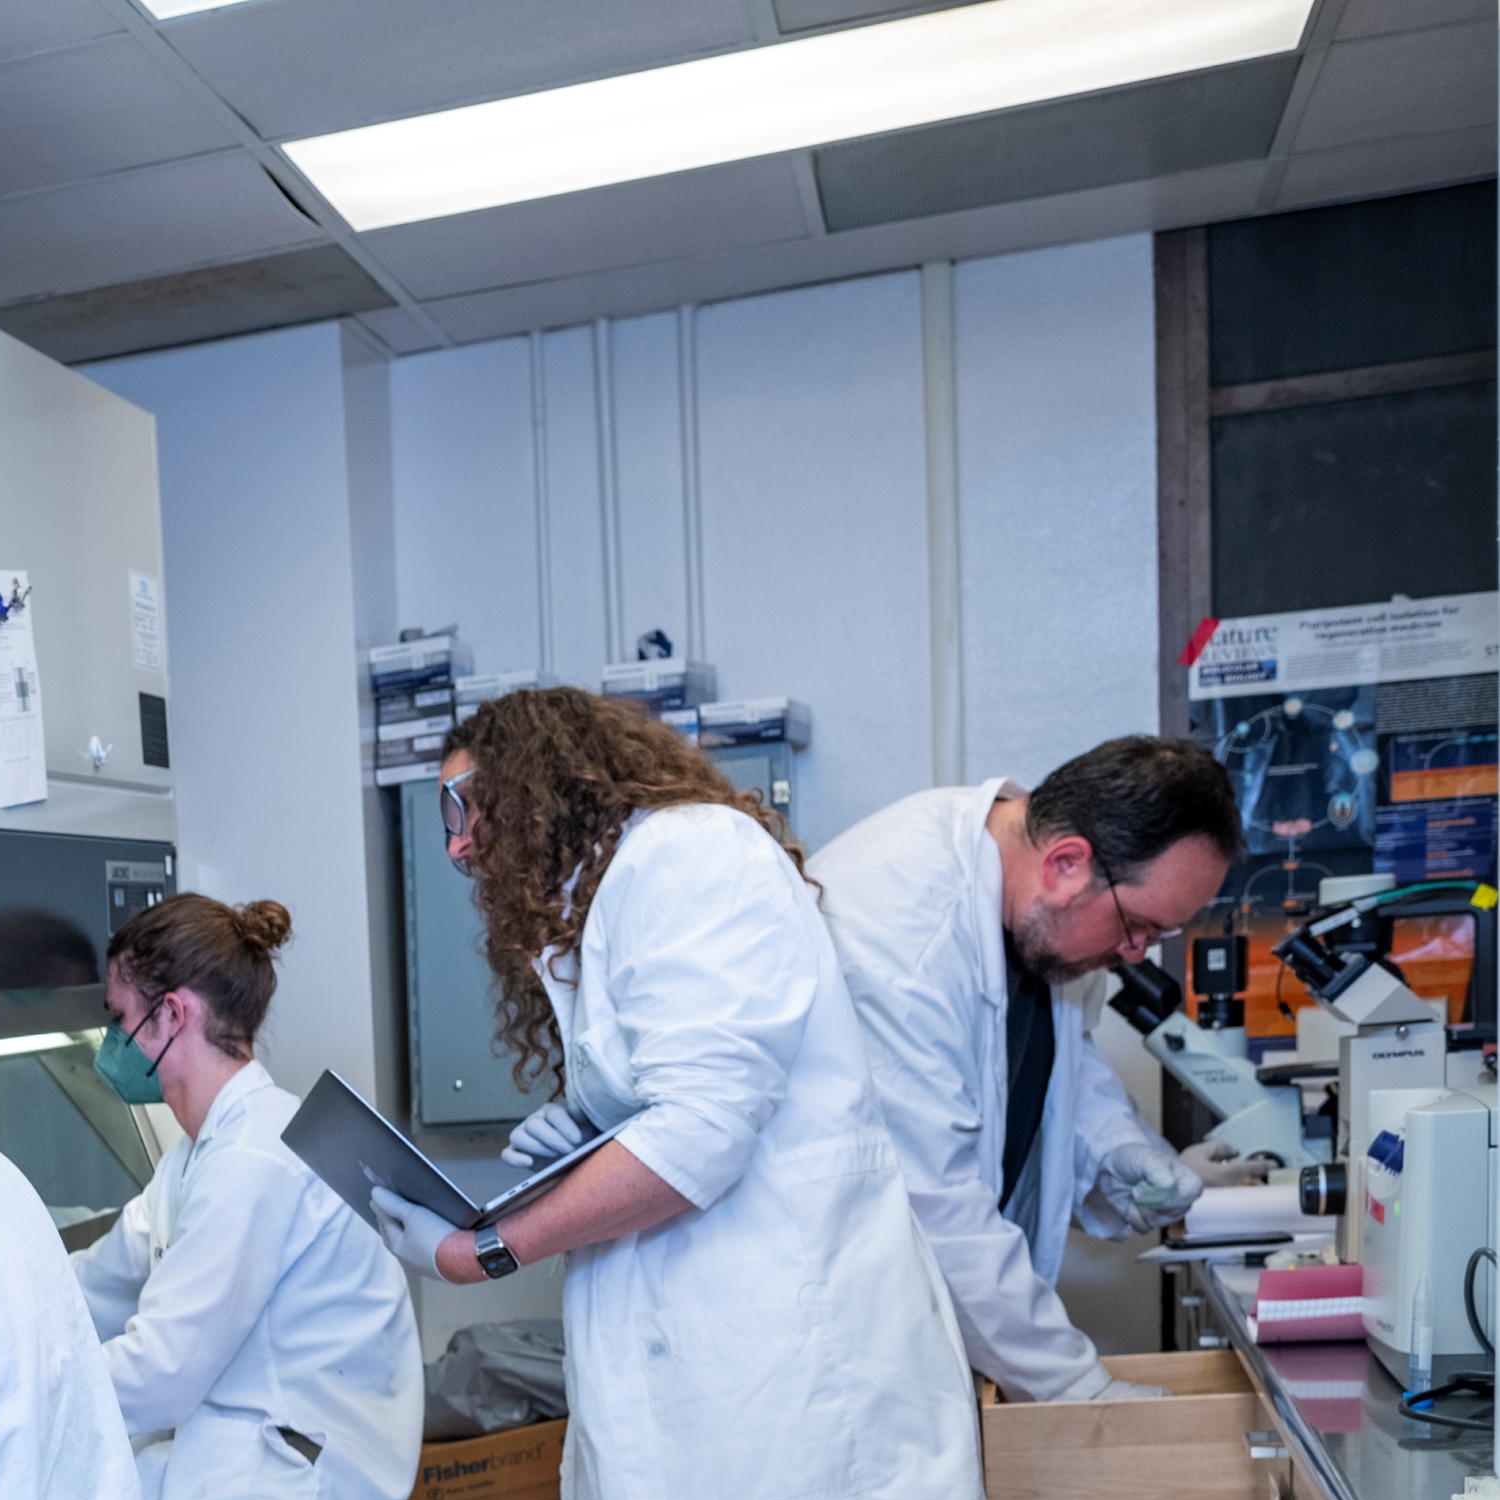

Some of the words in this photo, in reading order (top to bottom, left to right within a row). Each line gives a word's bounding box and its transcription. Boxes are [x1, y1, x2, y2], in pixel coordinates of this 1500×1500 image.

[1366, 612, 1387, 625] cell
[1388, 608, 1440, 623] isolation
[1442, 605, 1461, 616] for
[1389, 620, 1443, 634] medicine
[1210, 626, 1278, 648] ature
[1371, 1049, 1425, 1060] OLYMPUS
